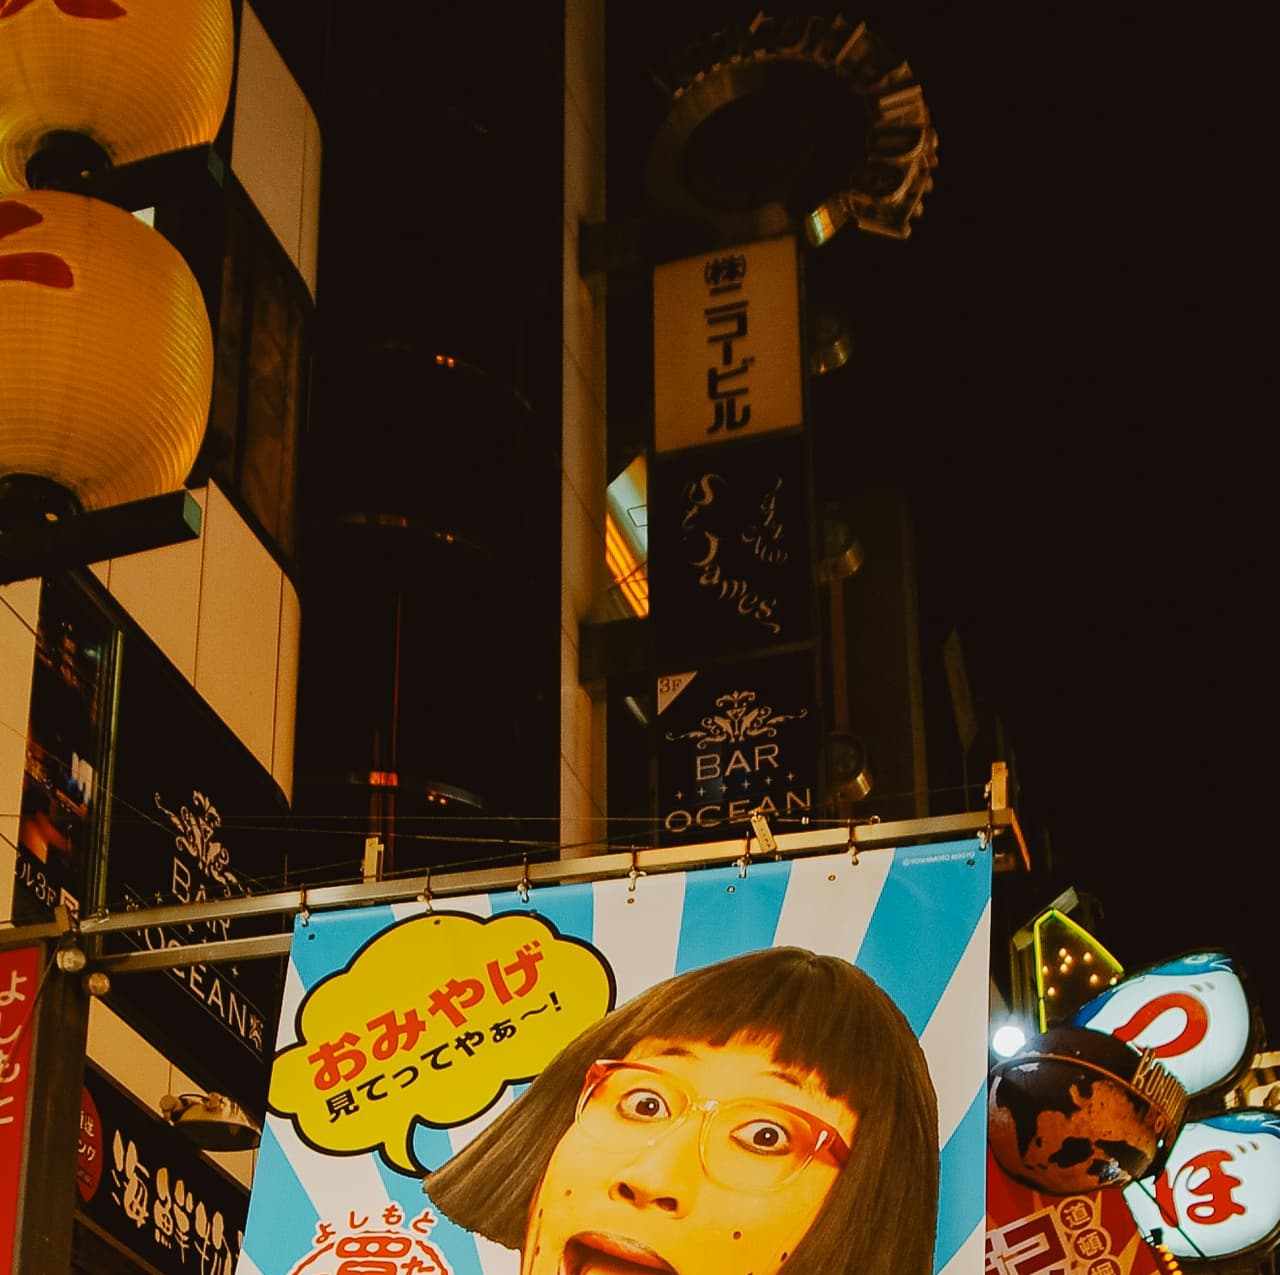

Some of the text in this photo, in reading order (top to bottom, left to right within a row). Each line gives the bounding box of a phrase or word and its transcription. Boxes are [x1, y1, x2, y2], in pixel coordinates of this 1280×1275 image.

[659, 677, 683, 694] 3F
[696, 743, 780, 781] BAR
[665, 787, 812, 833] OCEAN
[307, 940, 543, 1093] おみやげ
[314, 1205, 437, 1244] よしもと
